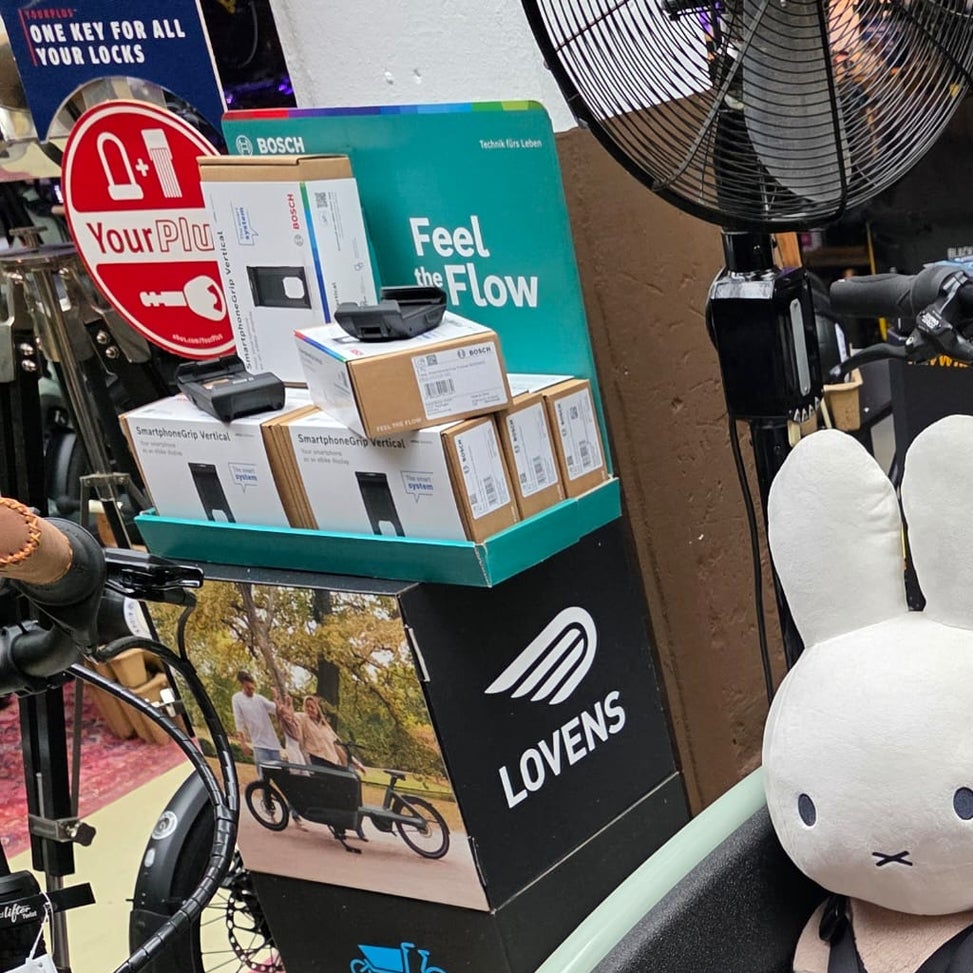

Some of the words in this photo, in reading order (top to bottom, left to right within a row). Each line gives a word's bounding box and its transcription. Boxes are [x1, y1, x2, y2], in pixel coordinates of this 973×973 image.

[29, 23, 67, 43] ONE
[70, 21, 104, 42] KEY
[109, 20, 147, 41] FOR
[152, 19, 186, 39] ALL
[35, 46, 85, 66] YOUR
[90, 44, 146, 65] LOCKS
[257, 136, 306, 154] BOSCH
[479, 138, 506, 150] Technik
[506, 138, 520, 149] fürs
[520, 138, 543, 149] Leben
[287, 193, 301, 230] BOSCH
[86, 217, 215, 254] YourPlu
[409, 215, 490, 257] Feel
[219, 230, 232, 275] Vertical
[414, 266, 443, 287] the
[444, 262, 538, 307] Flow
[229, 278, 252, 370] SmartphoneGrip
[469, 346, 492, 357] BOSCH
[135, 426, 199, 440] SmartphoneGrip
[200, 430, 231, 442] Vertical
[297, 433, 369, 448] SmartphoneGrip
[371, 437, 406, 449] Vertical
[235, 473, 257, 482] system
[408, 482, 434, 491] system
[499, 690, 626, 809] LOVENS
